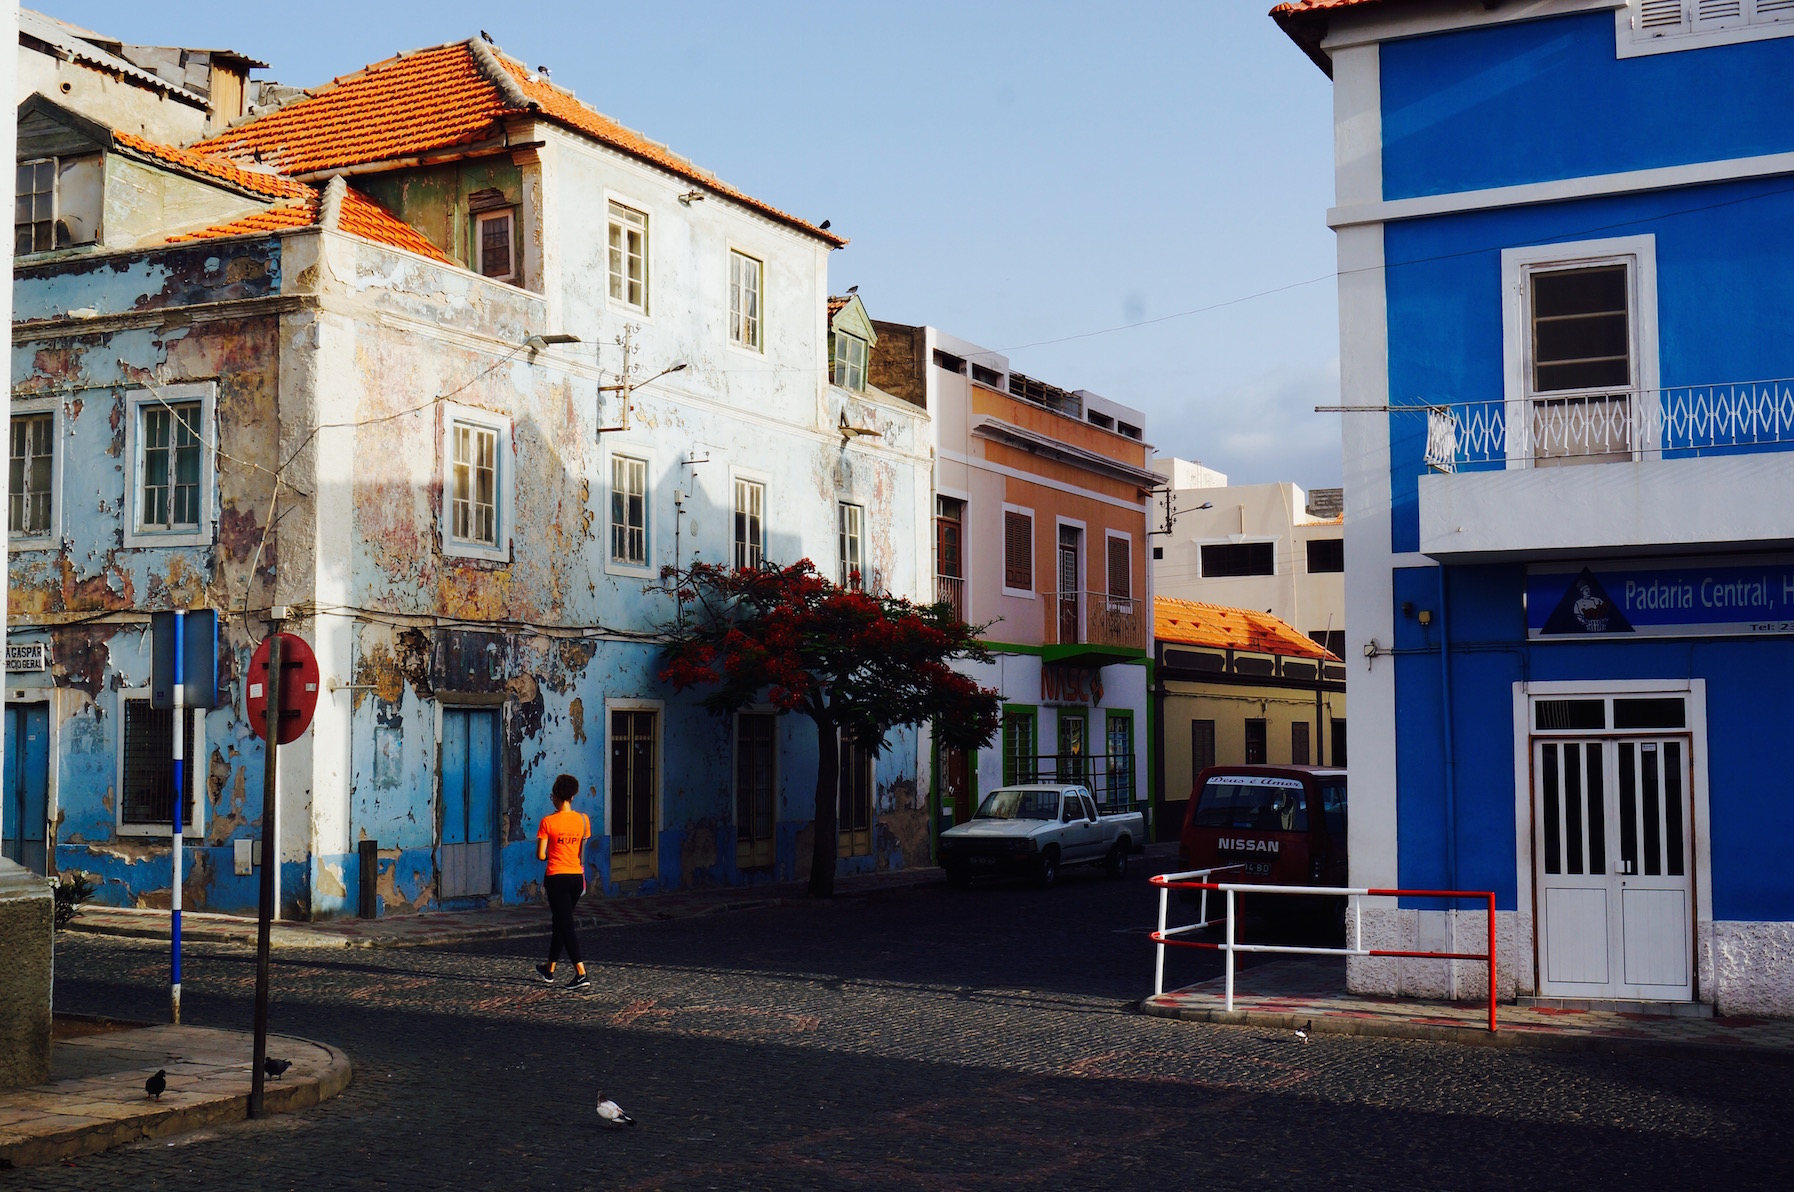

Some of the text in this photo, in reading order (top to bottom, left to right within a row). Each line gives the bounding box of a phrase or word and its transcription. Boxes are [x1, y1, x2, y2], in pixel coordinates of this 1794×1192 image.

[1625, 578, 1693, 610] Padaria
[1700, 576, 1774, 610] Central,
[22, 660, 42, 668] GERAL
[1261, 778, 1300, 787] Amor
[1218, 837, 1279, 853] NISSAN
